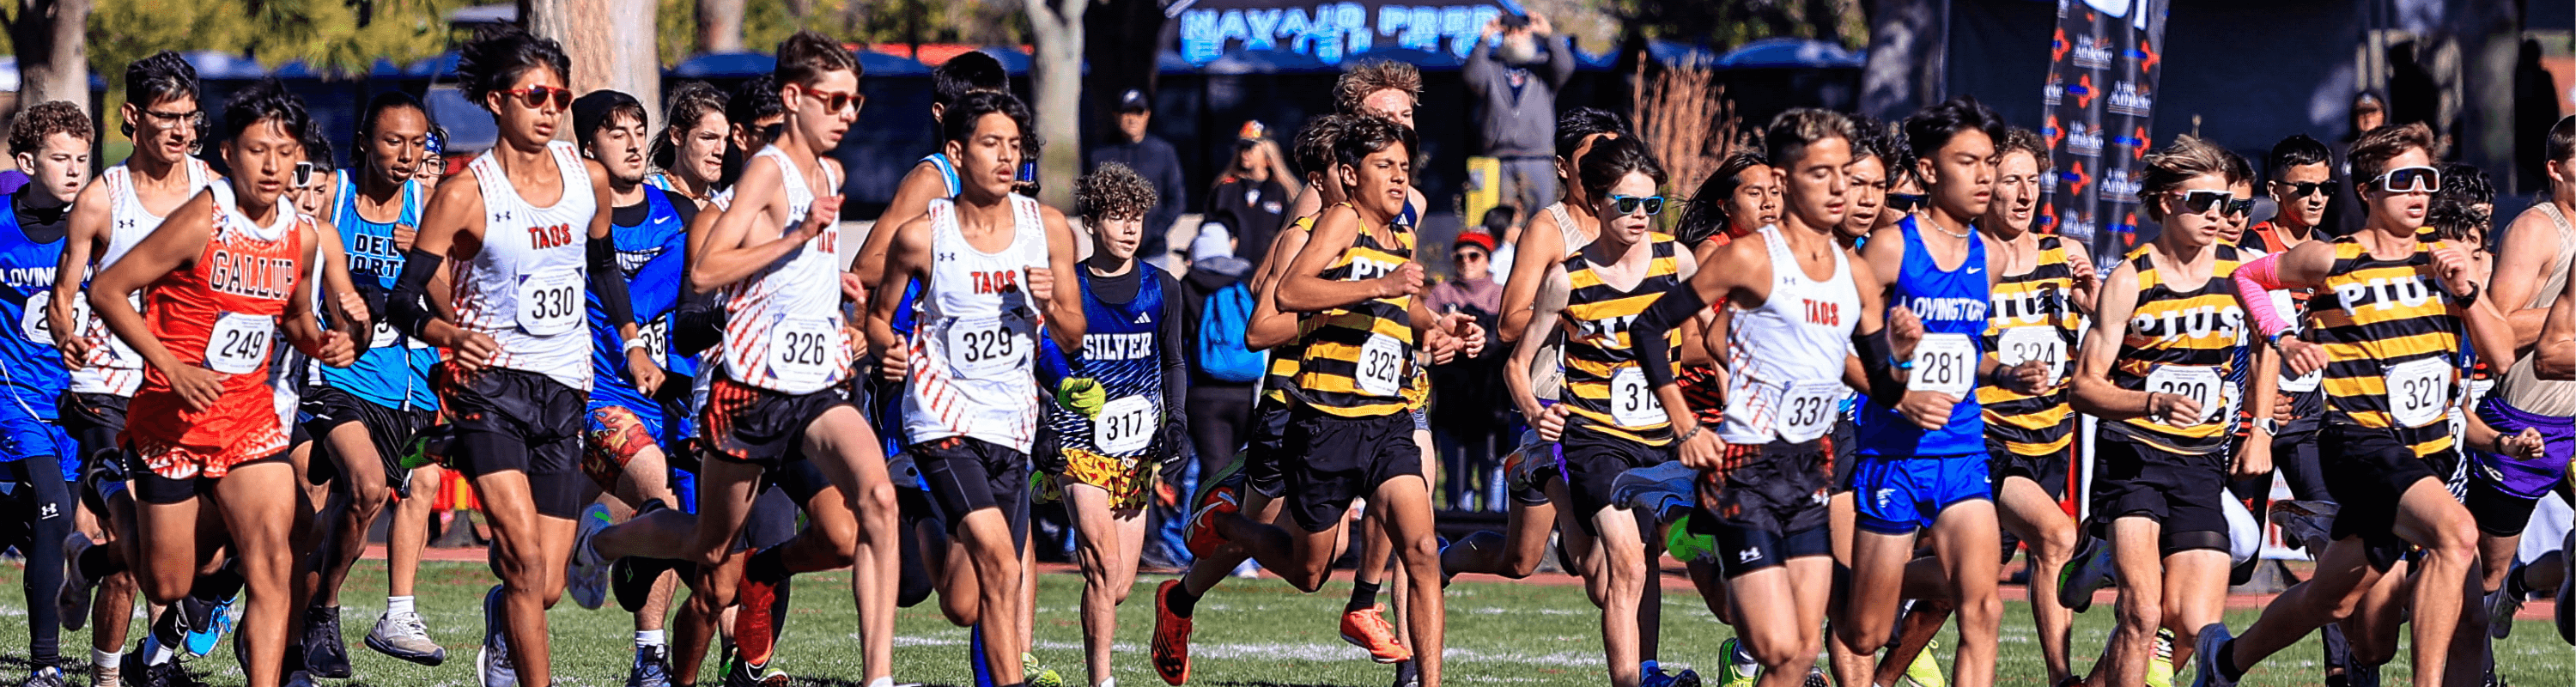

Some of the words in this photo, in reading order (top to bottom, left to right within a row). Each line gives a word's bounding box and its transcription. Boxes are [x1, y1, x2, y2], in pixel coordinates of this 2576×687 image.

[1181, 2, 1365, 39] NAVAJO
[2107, 90, 2151, 110] Athlete
[353, 233, 400, 258] DEL
[528, 223, 571, 250] TAOS
[209, 249, 293, 301] GALLUP
[344, 252, 405, 279] ORT
[970, 270, 1018, 294] TAOS
[2334, 275, 2445, 317] PIU
[532, 286, 574, 319] 330
[1802, 298, 1839, 326] TAOS
[2130, 305, 2245, 342] PIUS
[220, 329, 264, 359] 249
[782, 331, 825, 366] 326
[963, 326, 1013, 362] 329
[1083, 331, 1152, 361] SILVER
[2013, 342, 2056, 370] 324
[1366, 349, 1397, 383] 325
[1922, 352, 1963, 384] 281
[2403, 374, 2441, 410] 321
[1107, 410, 1143, 441] 317
[1789, 395, 1834, 427] 331
